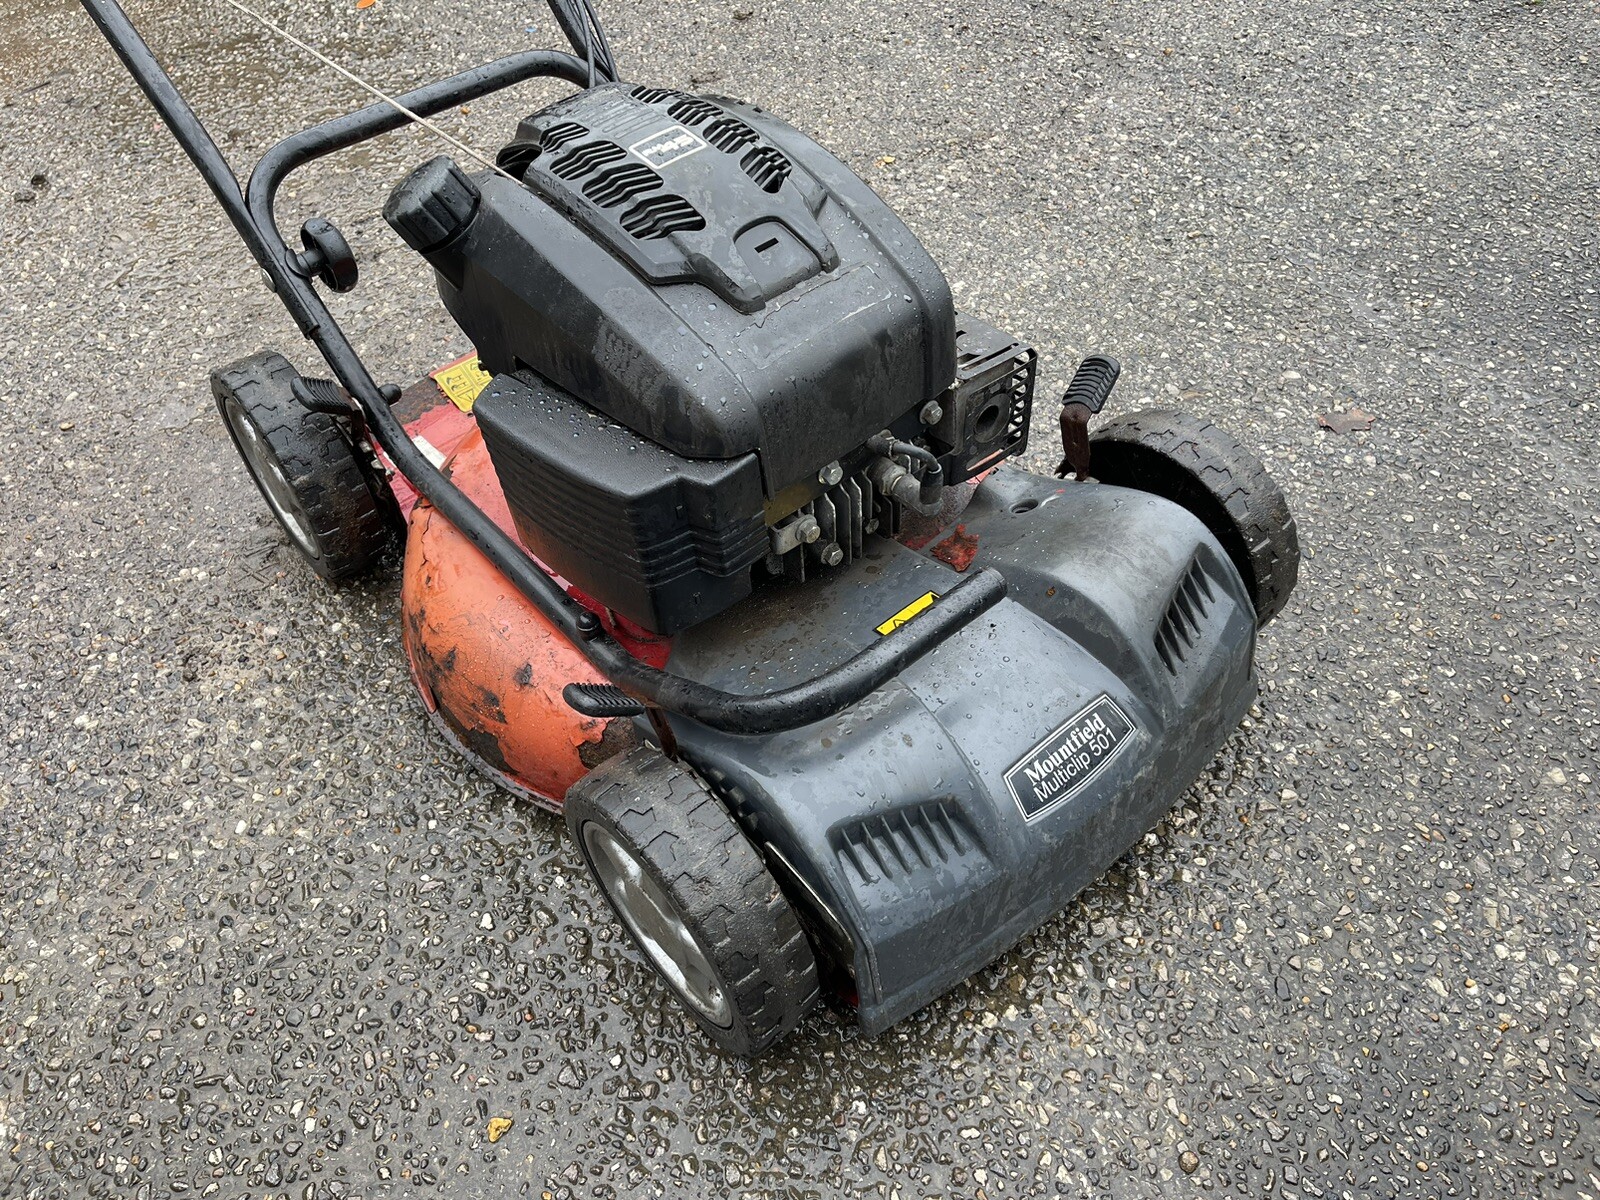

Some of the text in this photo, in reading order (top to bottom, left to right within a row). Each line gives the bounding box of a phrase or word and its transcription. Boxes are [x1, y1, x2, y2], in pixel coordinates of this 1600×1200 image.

[1023, 712, 1106, 785] Mountfield
[1033, 728, 1117, 802] Multiclip 501
